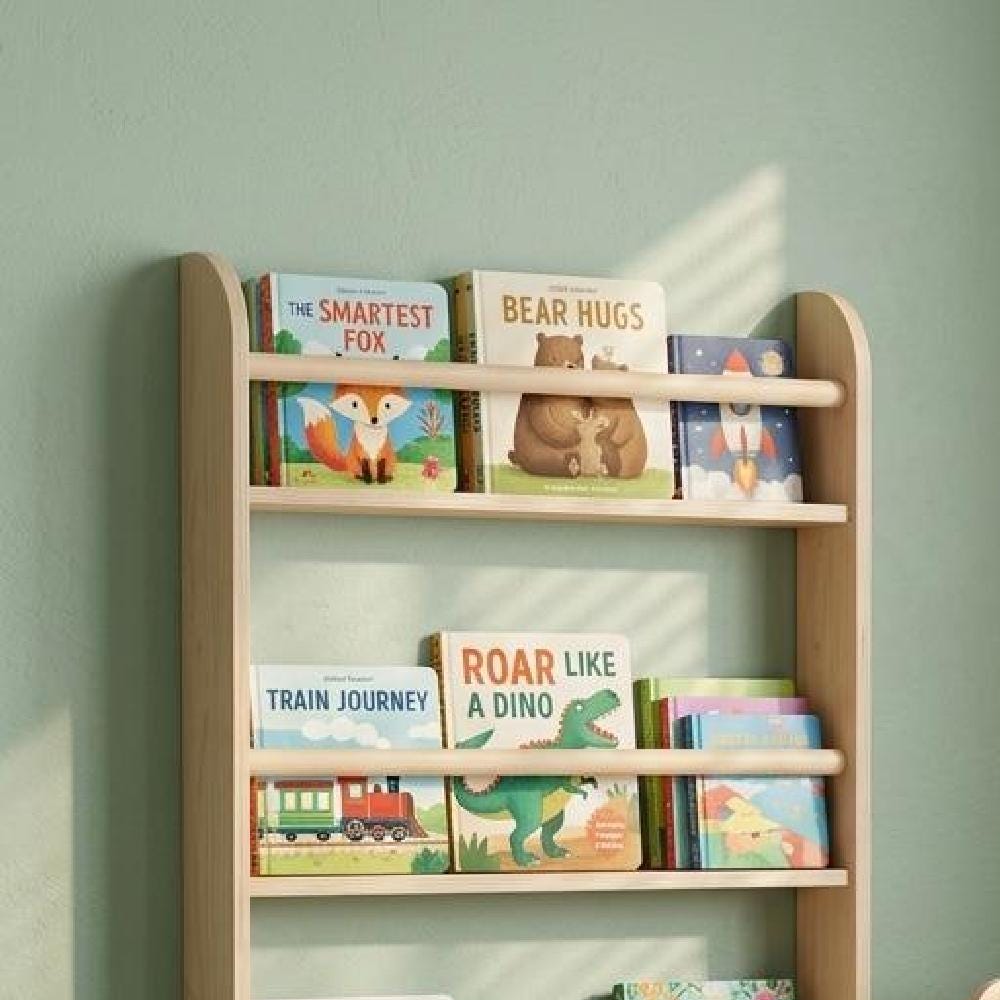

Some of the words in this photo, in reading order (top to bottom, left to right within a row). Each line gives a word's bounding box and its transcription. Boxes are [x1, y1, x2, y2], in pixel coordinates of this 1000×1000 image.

[288, 302, 314, 318] THE
[319, 298, 433, 329] SMARTEST
[503, 295, 568, 325] BEAR
[578, 299, 645, 331] HUGS
[343, 328, 386, 353] FOX
[462, 648, 556, 685] ROAR
[564, 650, 617, 677] LIKE
[266, 689, 330, 712] TRAIN
[338, 690, 429, 712] JOURNEY
[468, 691, 486, 719] A
[492, 691, 554, 719] DINO
